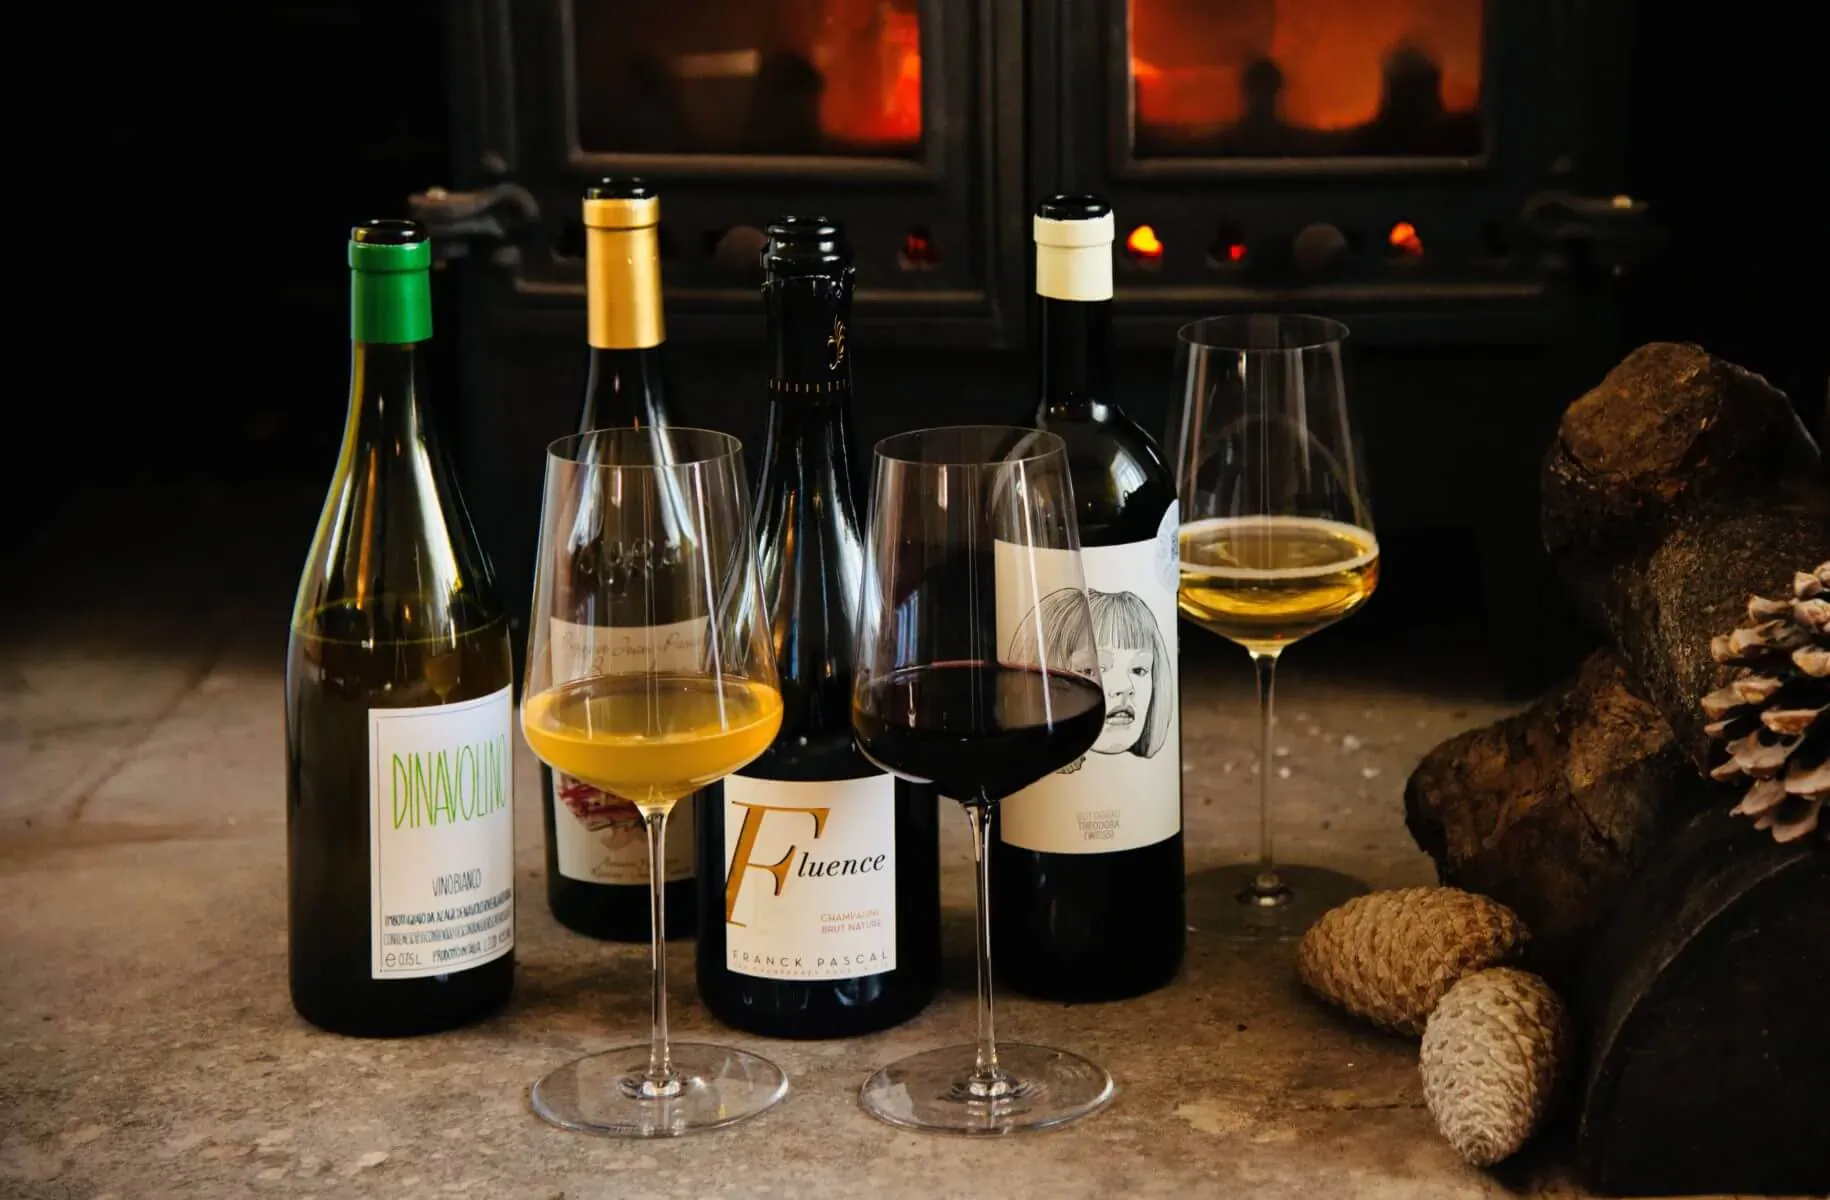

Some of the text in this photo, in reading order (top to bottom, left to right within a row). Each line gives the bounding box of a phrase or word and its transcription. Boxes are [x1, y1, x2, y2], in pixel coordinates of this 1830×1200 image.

[392, 733, 508, 831] DINAVOLINO
[821, 918, 881, 934] BRUT NATURE
[732, 949, 888, 968] FRANCK PASCAL
